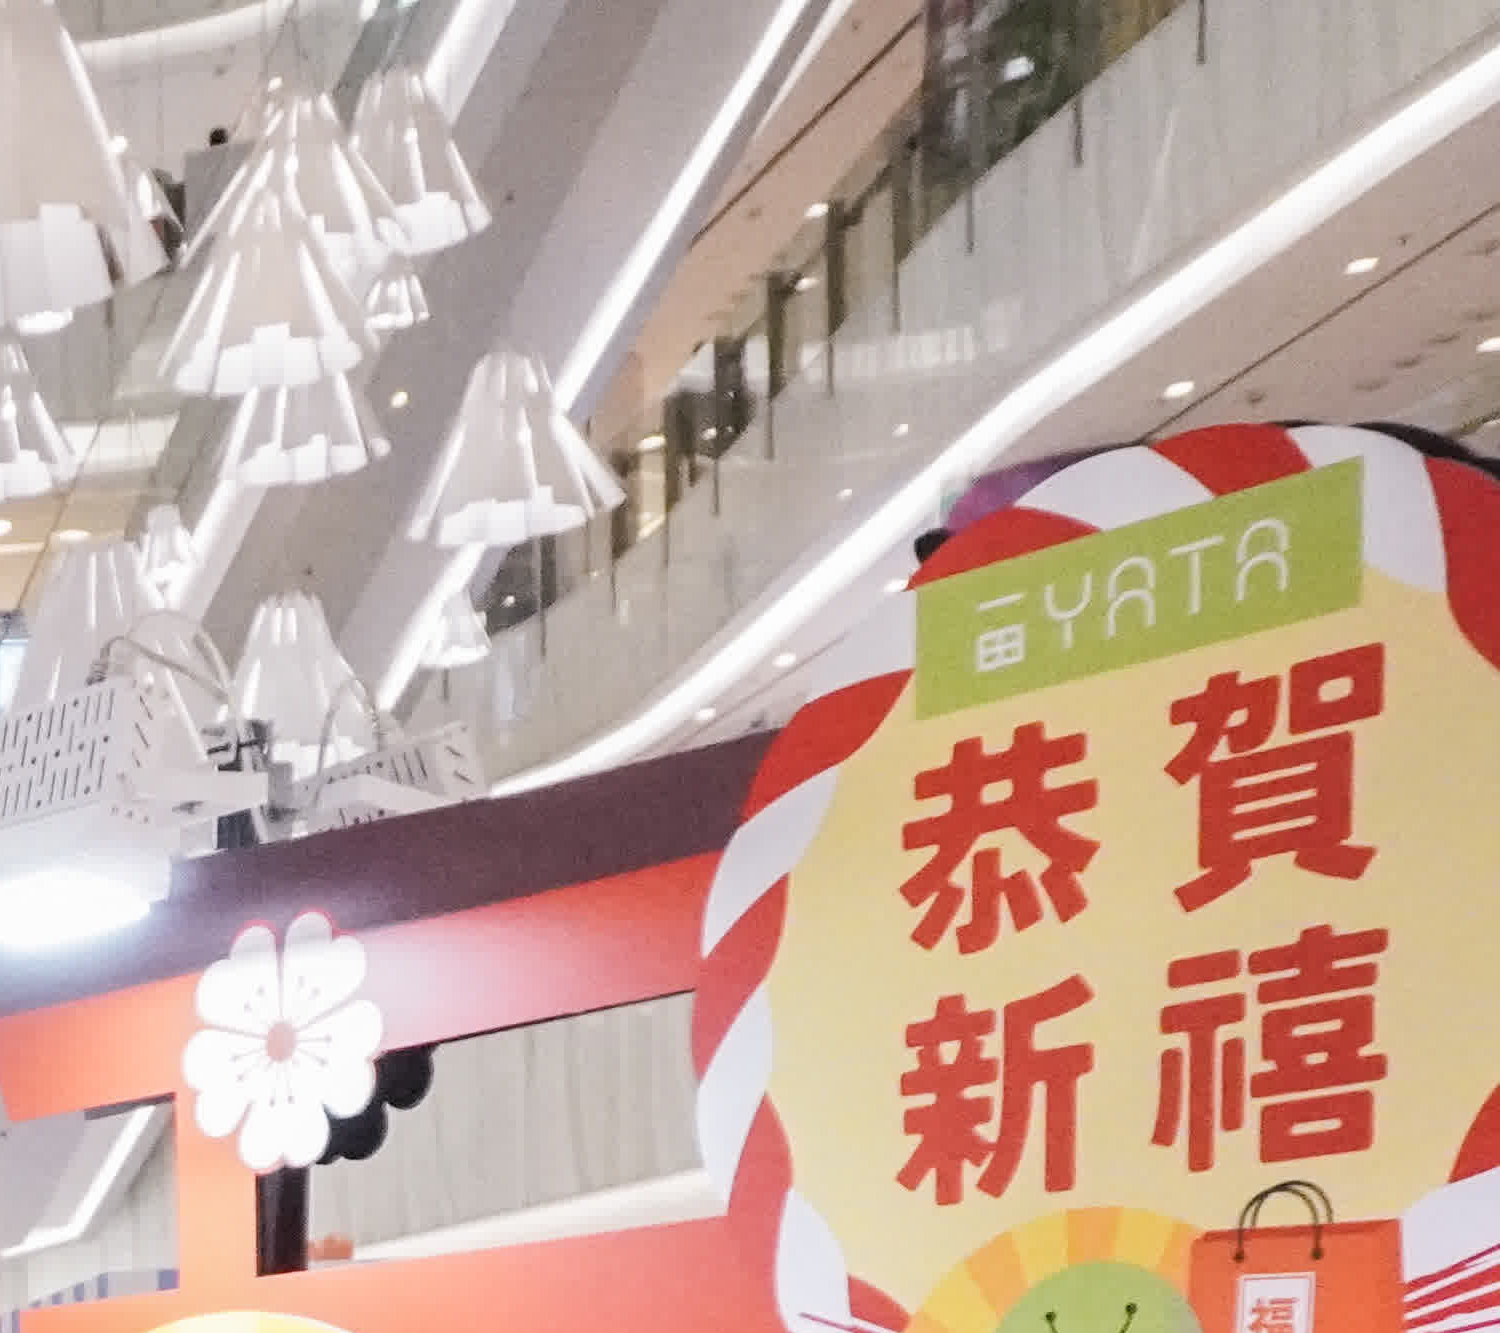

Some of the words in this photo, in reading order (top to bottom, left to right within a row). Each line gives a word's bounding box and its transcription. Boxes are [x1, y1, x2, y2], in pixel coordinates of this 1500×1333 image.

[1044, 514, 1292, 650] YATA
[898, 642, 1386, 957] 恭賀
[896, 922, 1389, 1206] 新禧
